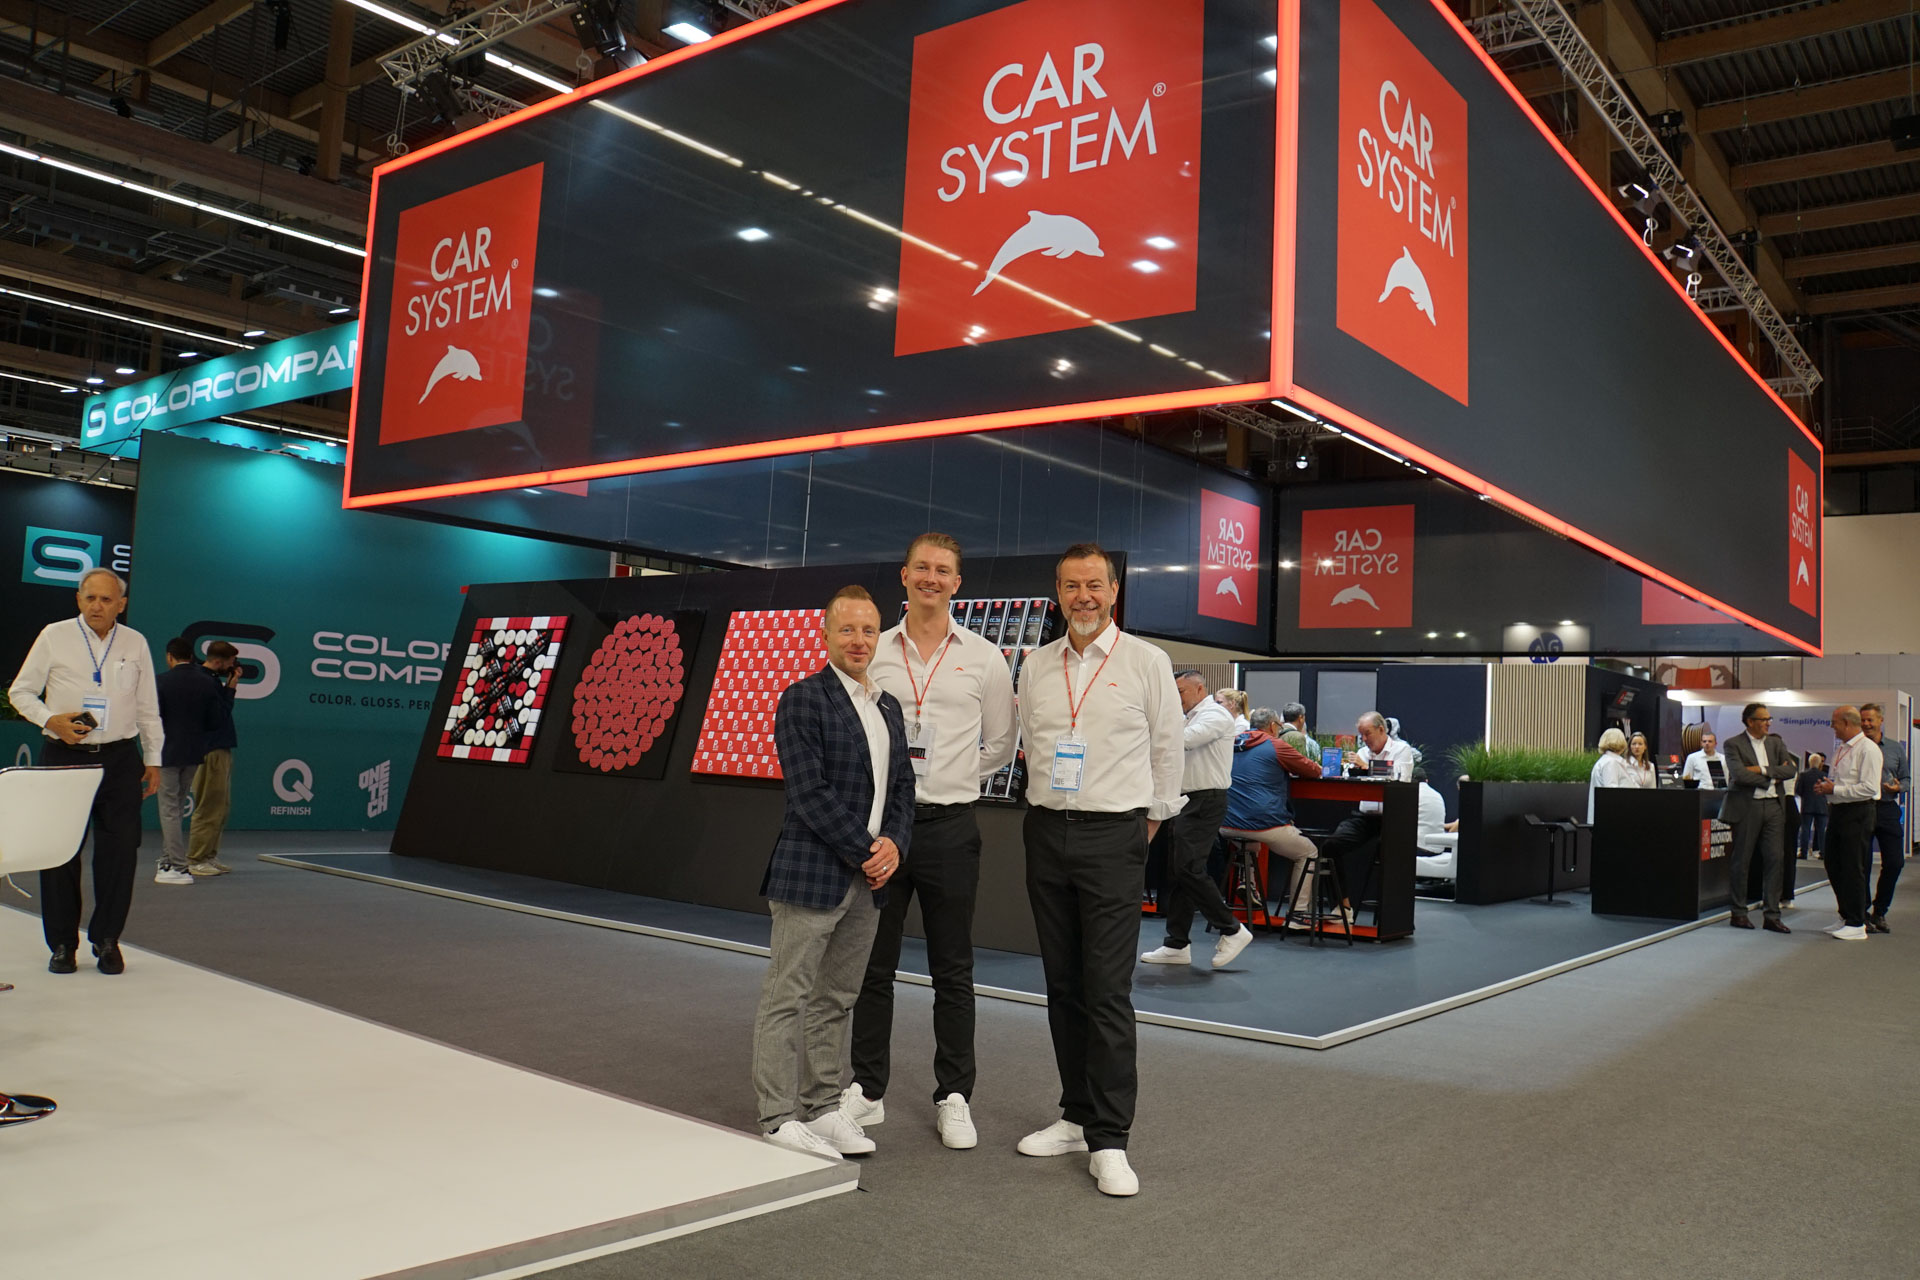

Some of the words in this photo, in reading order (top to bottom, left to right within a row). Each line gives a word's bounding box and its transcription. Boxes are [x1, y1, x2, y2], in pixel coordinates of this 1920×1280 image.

[982, 43, 1108, 125] CAR
[1379, 80, 1435, 179] CAR
[431, 226, 492, 282] CAR
[309, 693, 357, 706] COLOR.
[360, 696, 405, 709] GLOSS.
[270, 806, 312, 816] REFINISH
